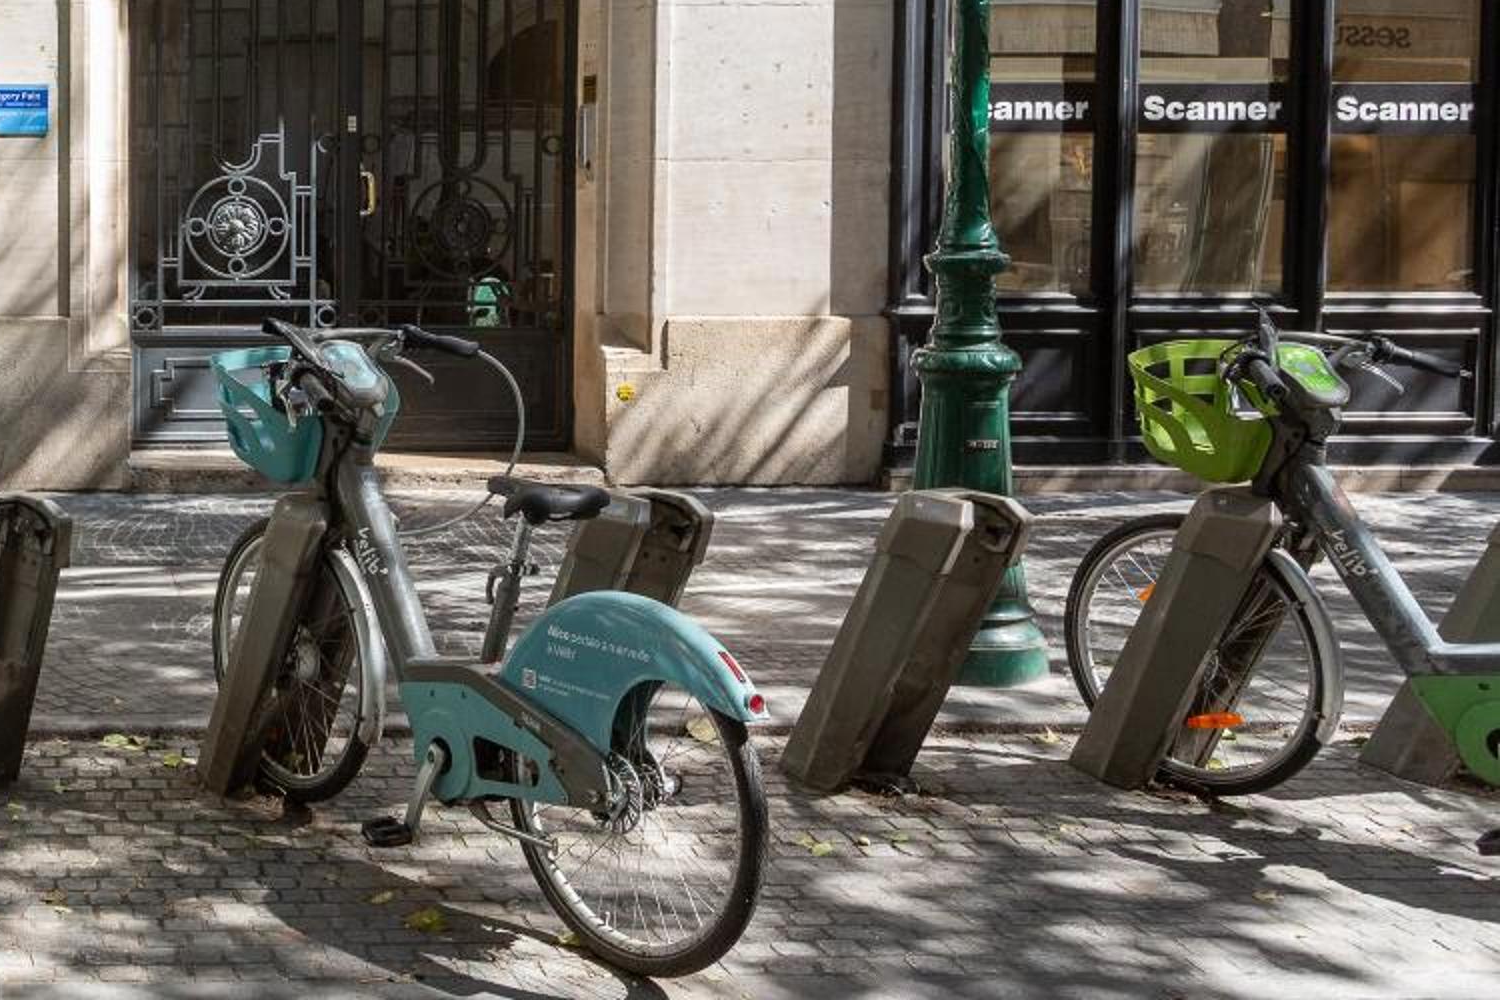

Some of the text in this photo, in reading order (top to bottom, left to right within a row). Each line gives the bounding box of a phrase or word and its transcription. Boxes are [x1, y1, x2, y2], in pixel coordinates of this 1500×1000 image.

[987, 101, 1088, 121] anner
[1143, 95, 1282, 121] Scanner
[1336, 96, 1474, 122] Scanner
